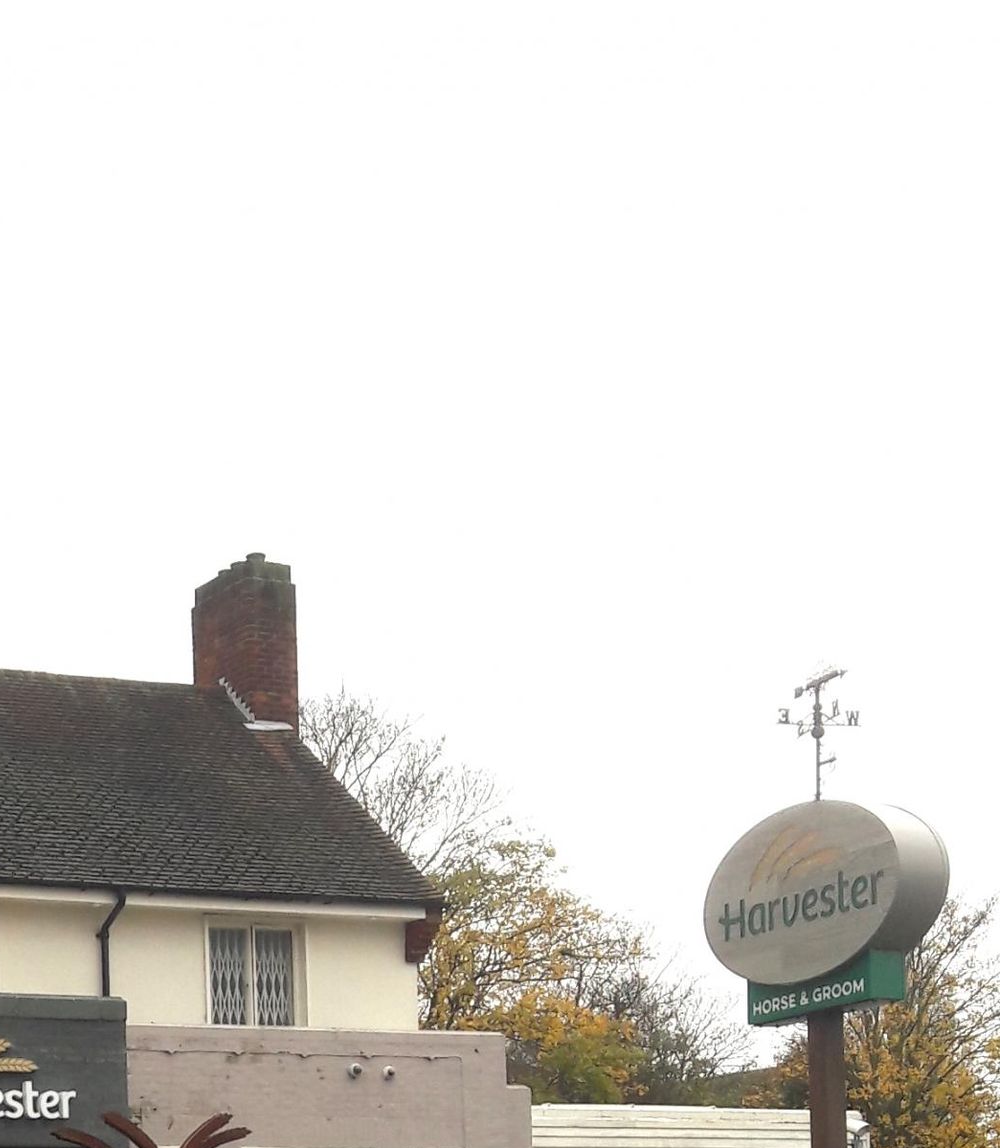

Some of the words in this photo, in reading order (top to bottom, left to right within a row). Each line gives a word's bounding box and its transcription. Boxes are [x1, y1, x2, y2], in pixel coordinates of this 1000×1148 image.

[718, 869, 883, 942] Harvester
[753, 993, 796, 1016] HORSE
[800, 991, 809, 1006] &
[812, 978, 865, 1002] GROOM
